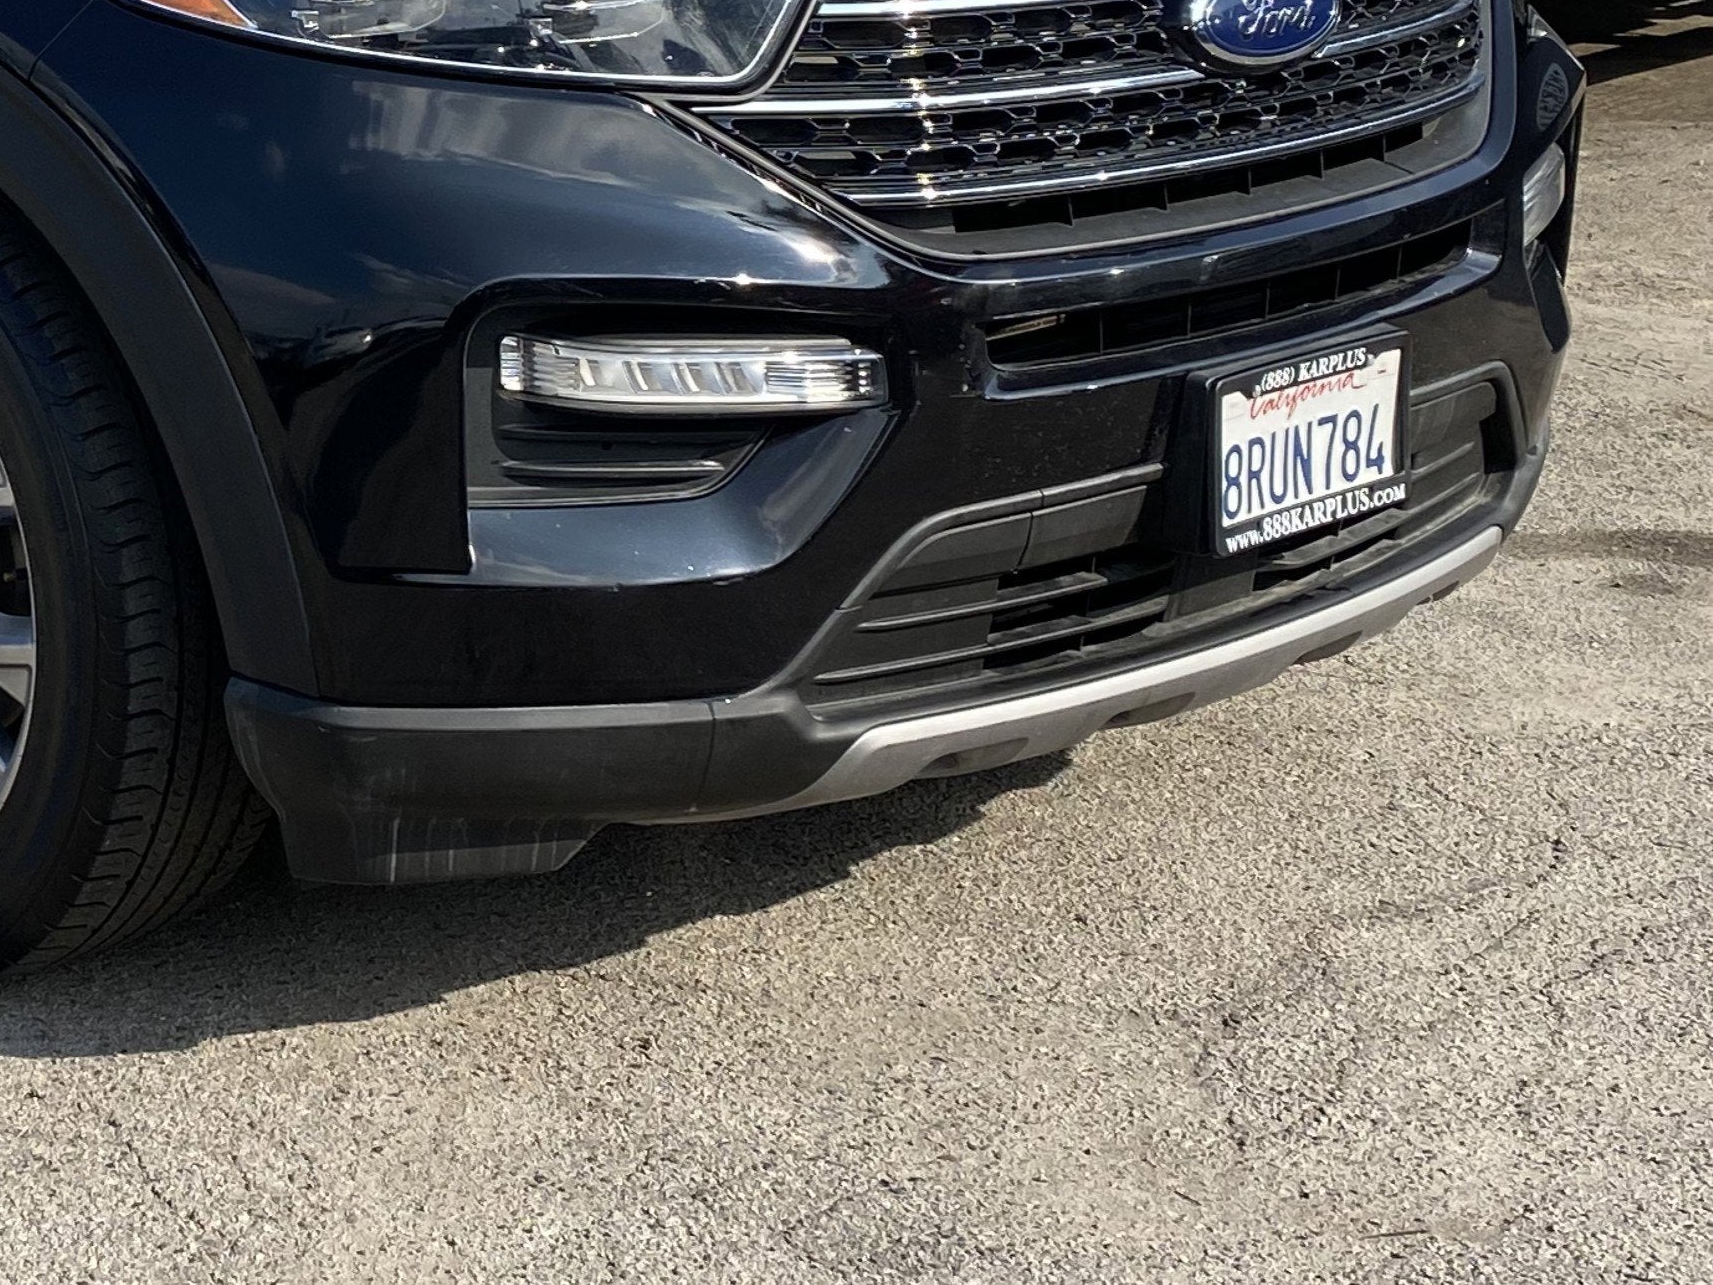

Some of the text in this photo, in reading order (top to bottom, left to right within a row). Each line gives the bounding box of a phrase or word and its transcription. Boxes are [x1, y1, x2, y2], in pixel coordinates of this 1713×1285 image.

[1260, 347, 1367, 393] (888) KARPLUS
[1222, 403, 1385, 520] 8RUN784
